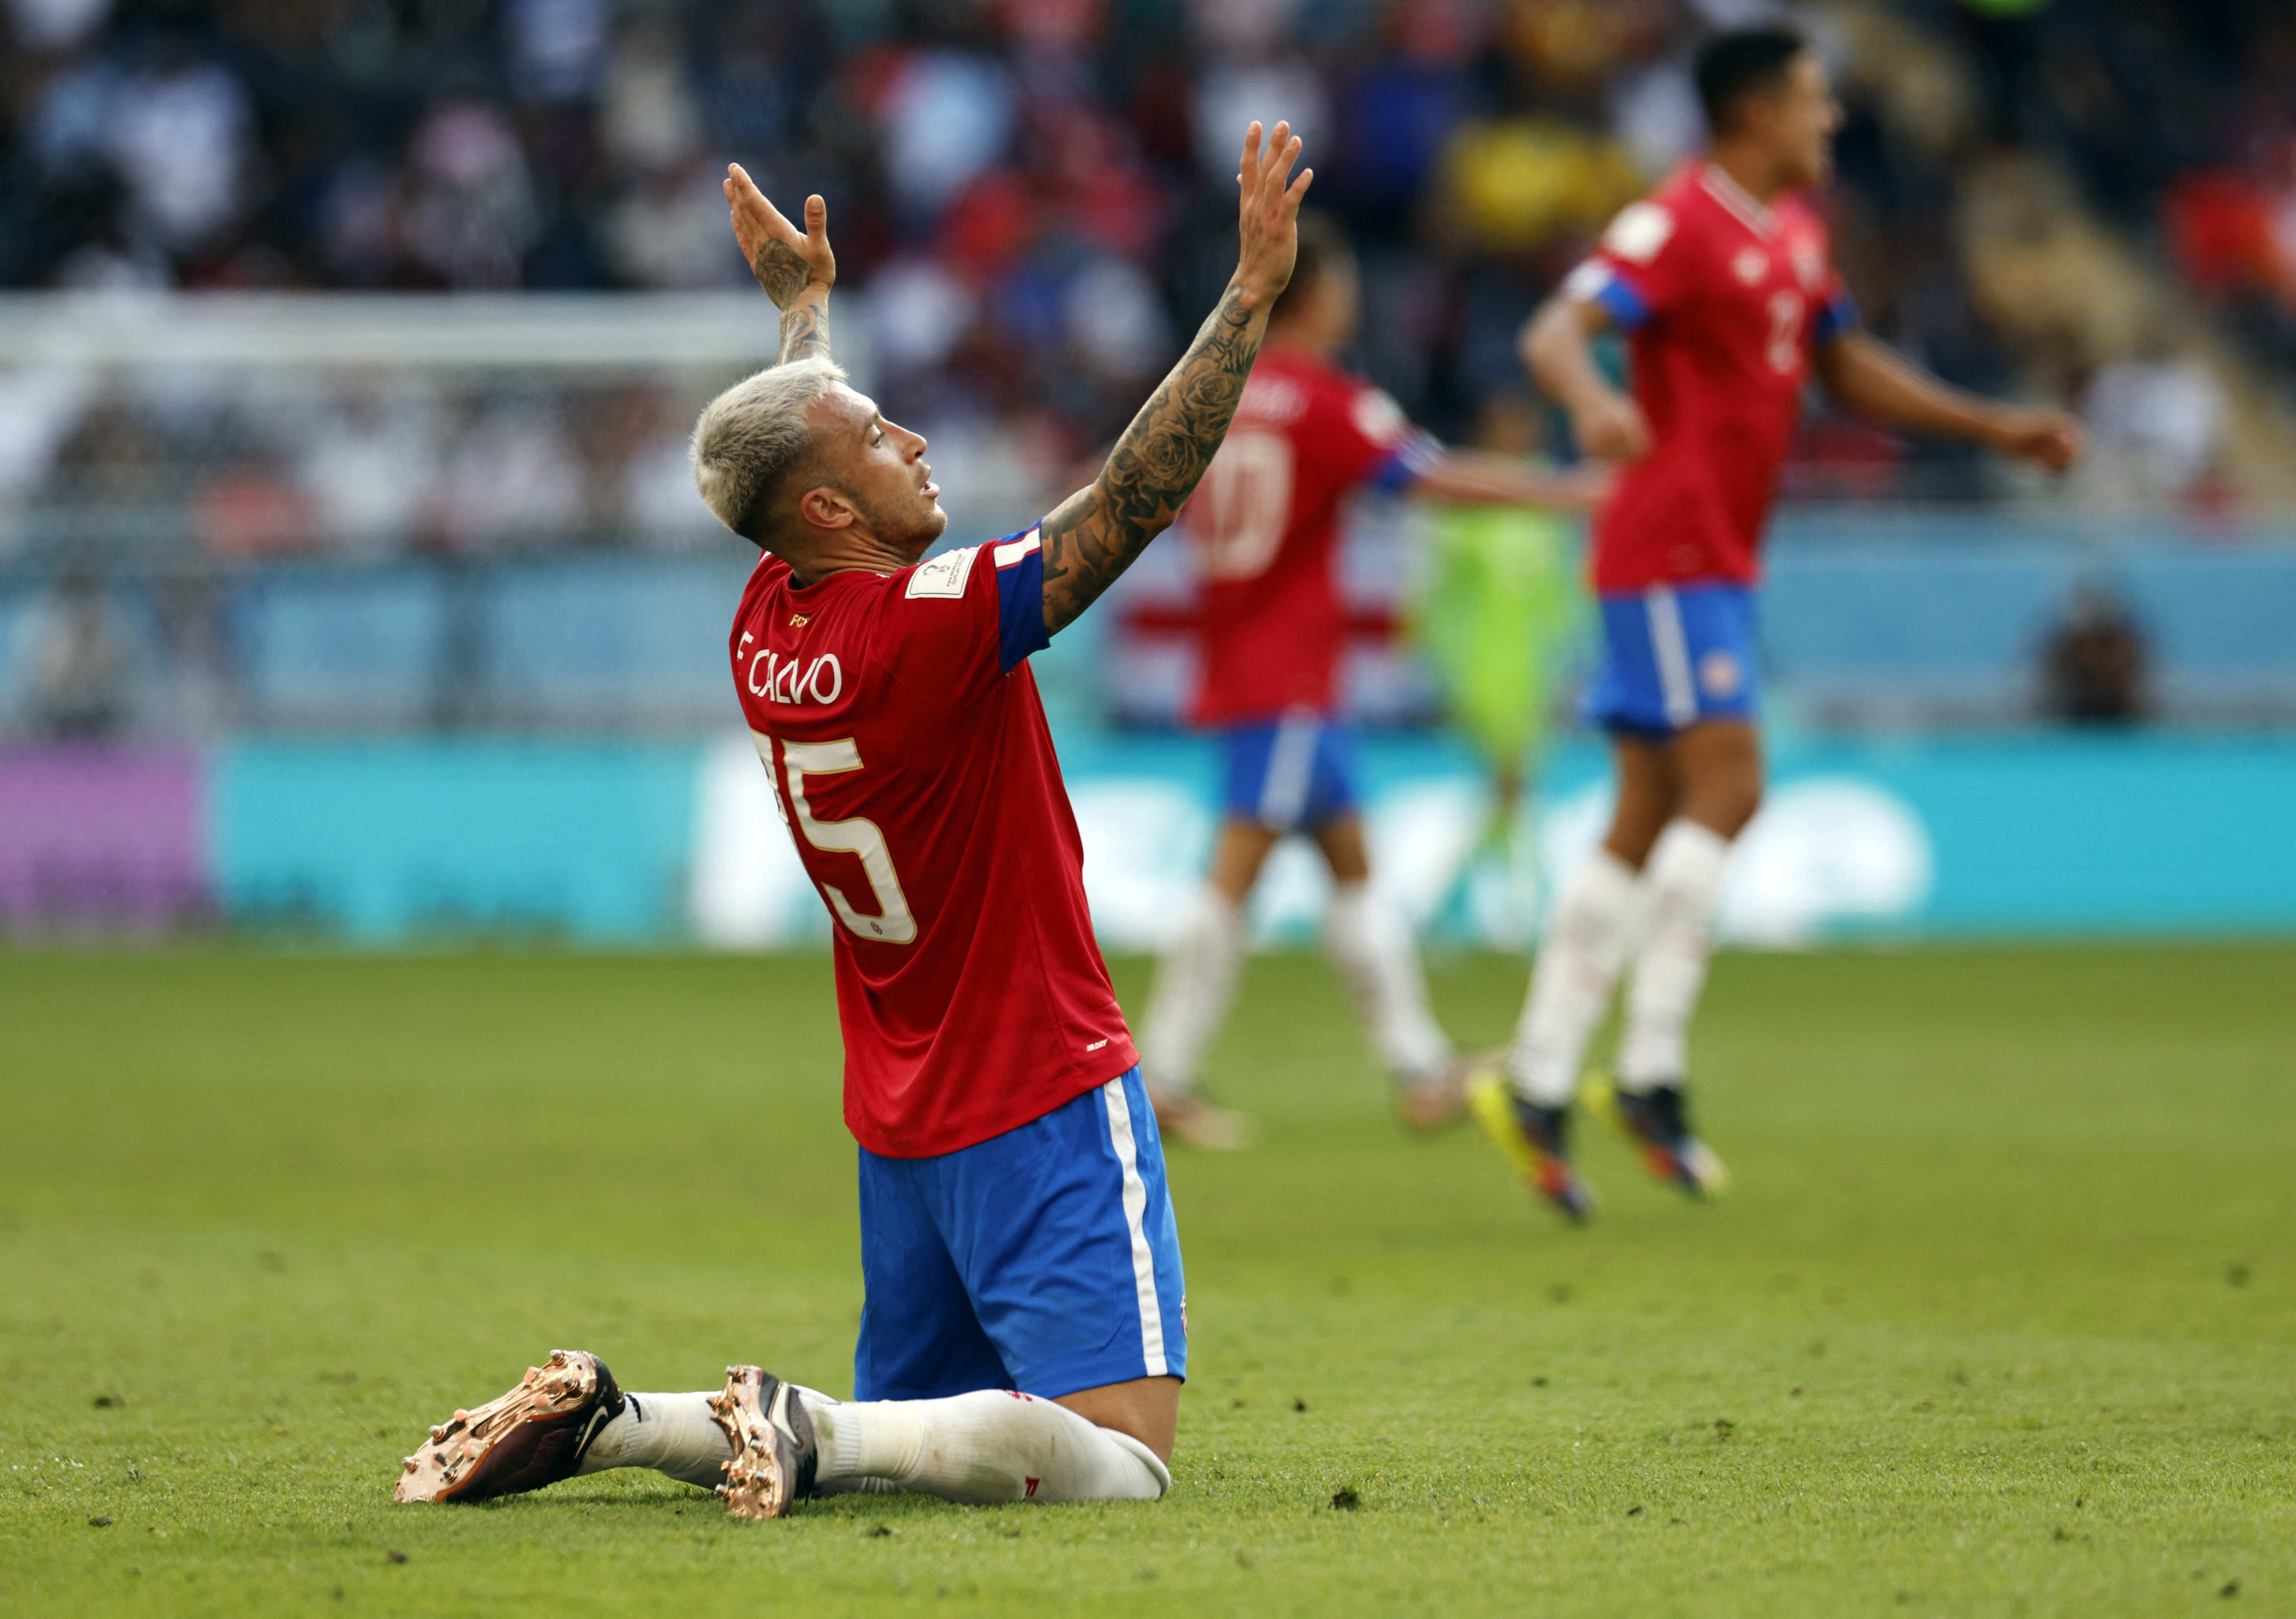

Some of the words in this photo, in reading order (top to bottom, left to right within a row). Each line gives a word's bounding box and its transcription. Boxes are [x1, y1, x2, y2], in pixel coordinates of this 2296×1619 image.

[950, 561, 959, 576] WORLD
[957, 556, 966, 567] 2022
[748, 649, 842, 704] CALVO
